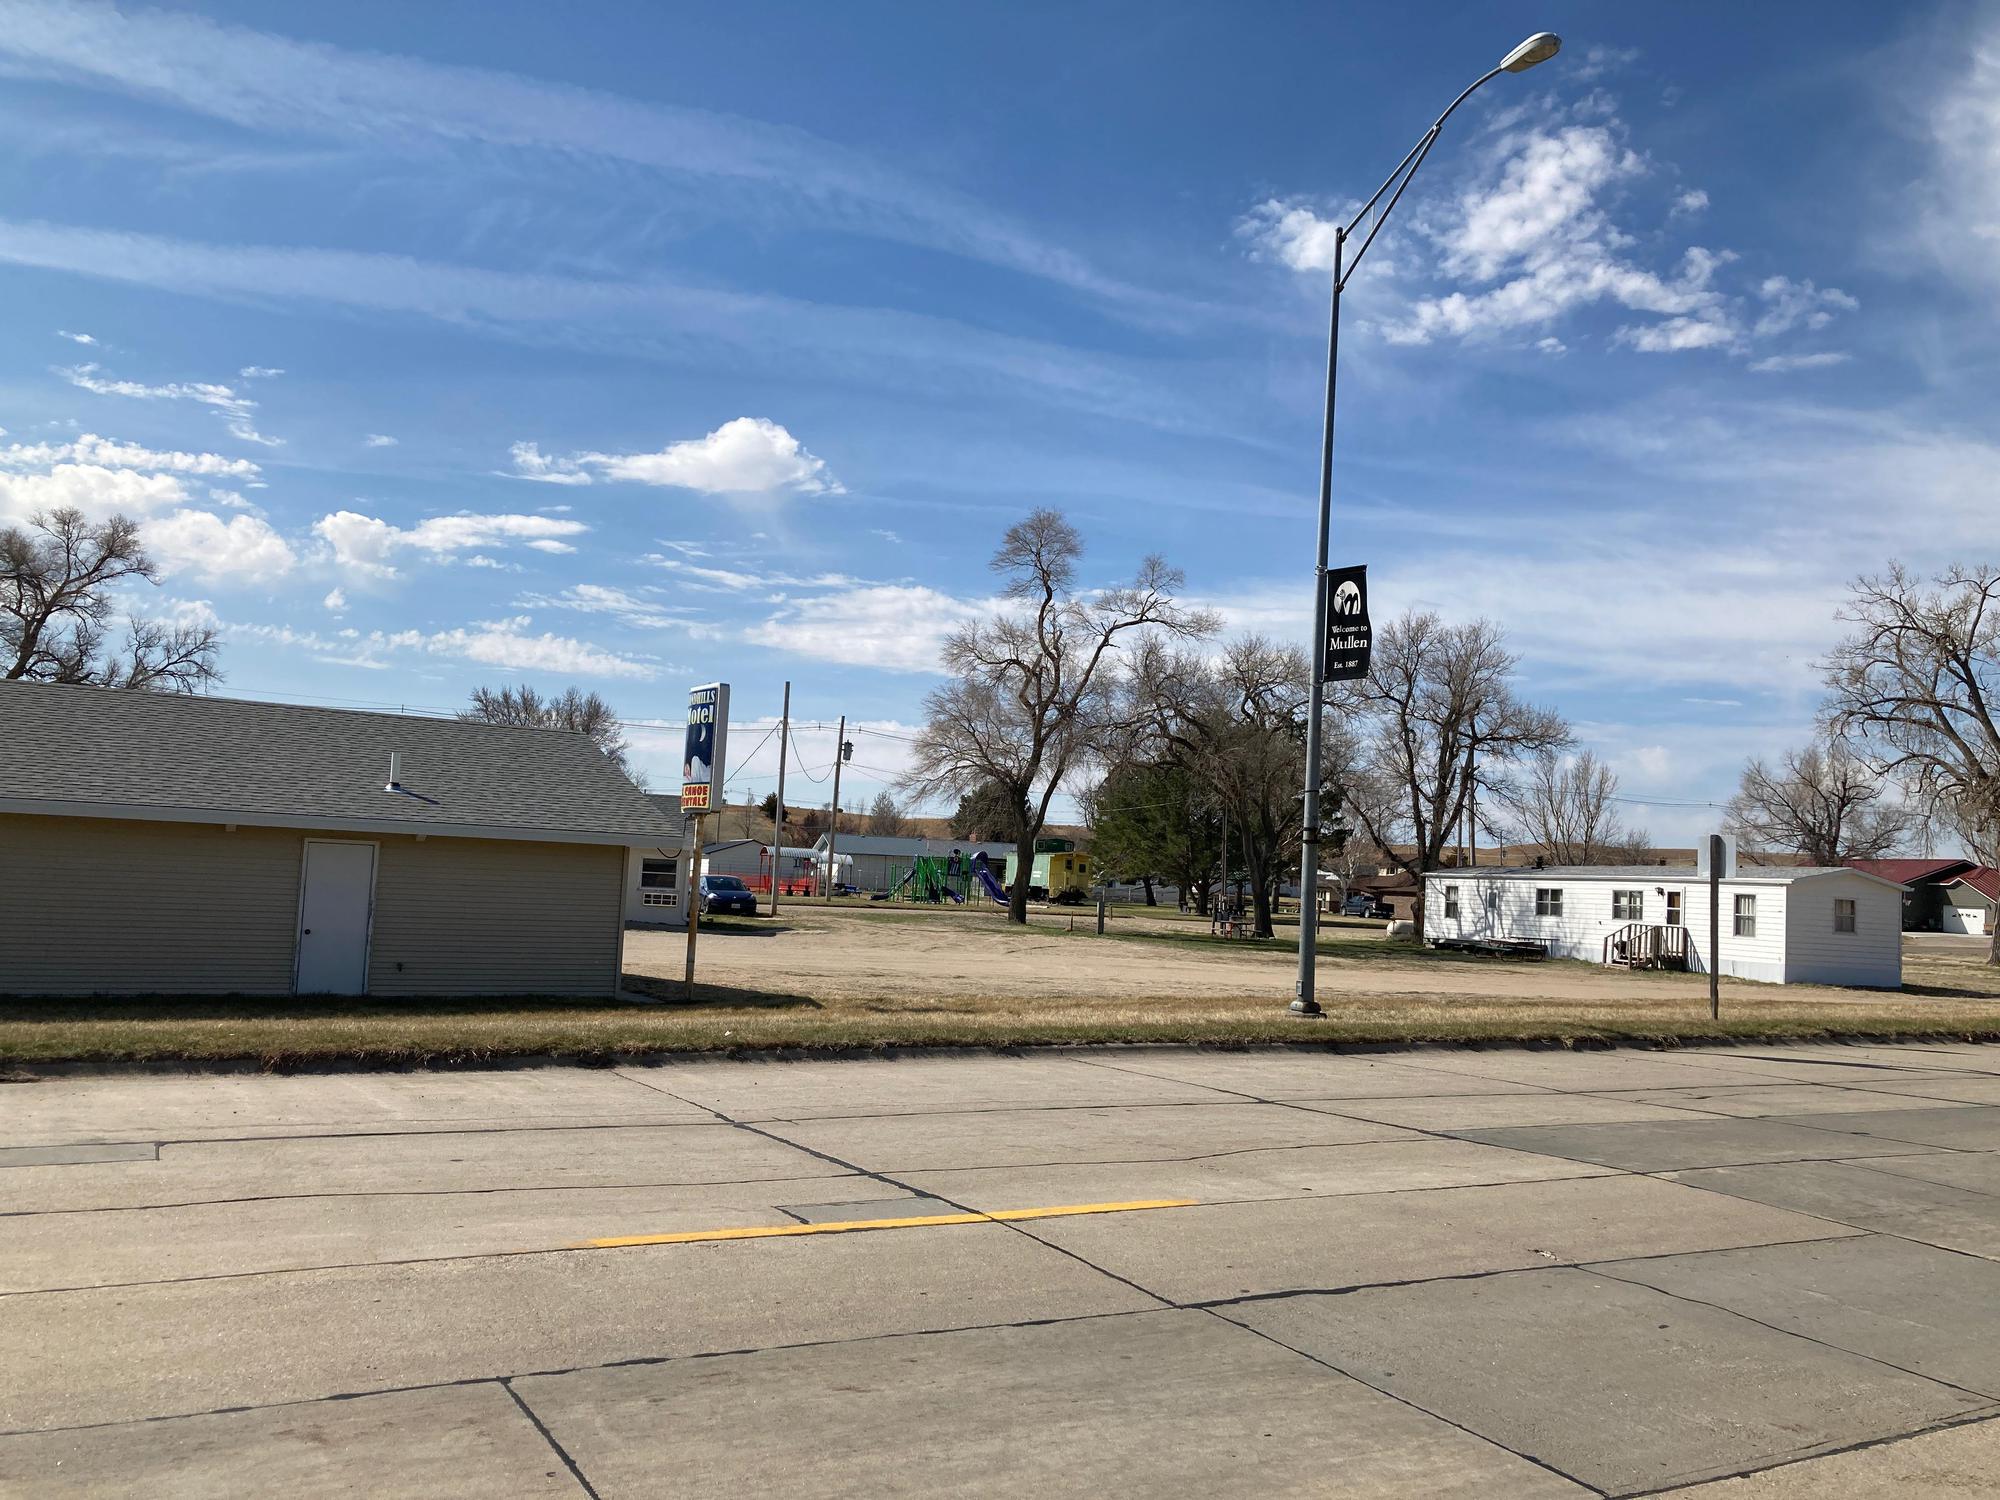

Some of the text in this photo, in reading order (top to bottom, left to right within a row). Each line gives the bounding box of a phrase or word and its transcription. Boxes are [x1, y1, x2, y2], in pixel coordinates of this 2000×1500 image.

[1332, 625, 1359, 633] Welcome
[1330, 635, 1368, 650] Mullen
[685, 786, 708, 796] CANOE
